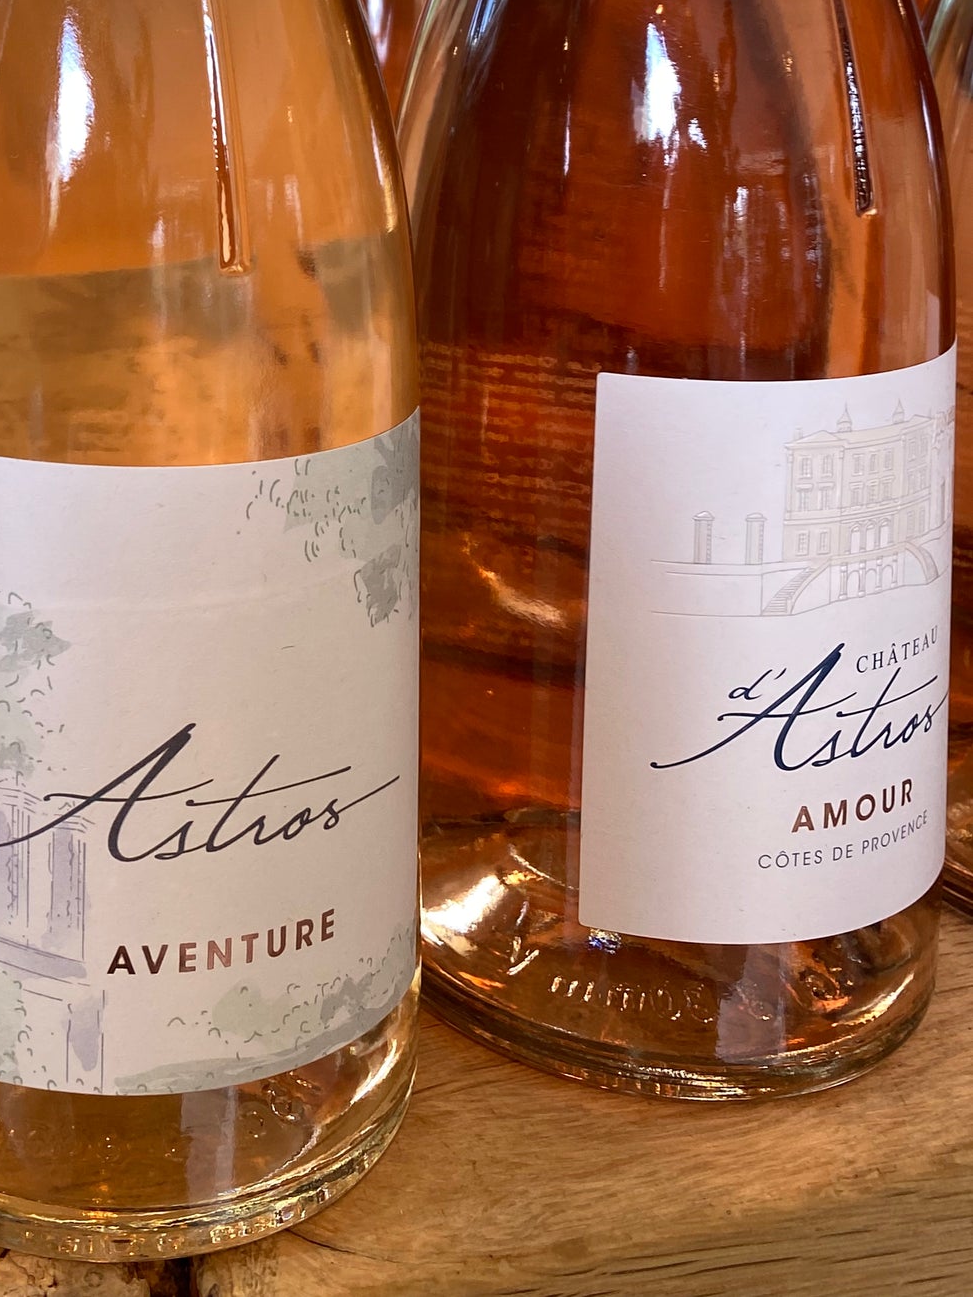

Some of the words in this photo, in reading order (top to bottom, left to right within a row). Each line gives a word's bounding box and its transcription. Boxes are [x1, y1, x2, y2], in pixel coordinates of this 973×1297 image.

[855, 625, 939, 674] CHÂTEAU
[791, 778, 913, 834] AMOUR
[757, 849, 823, 870] CÔTES
[832, 843, 854, 862] DE
[861, 809, 929, 855] PROVENCE
[107, 908, 337, 976] AVENTURE
